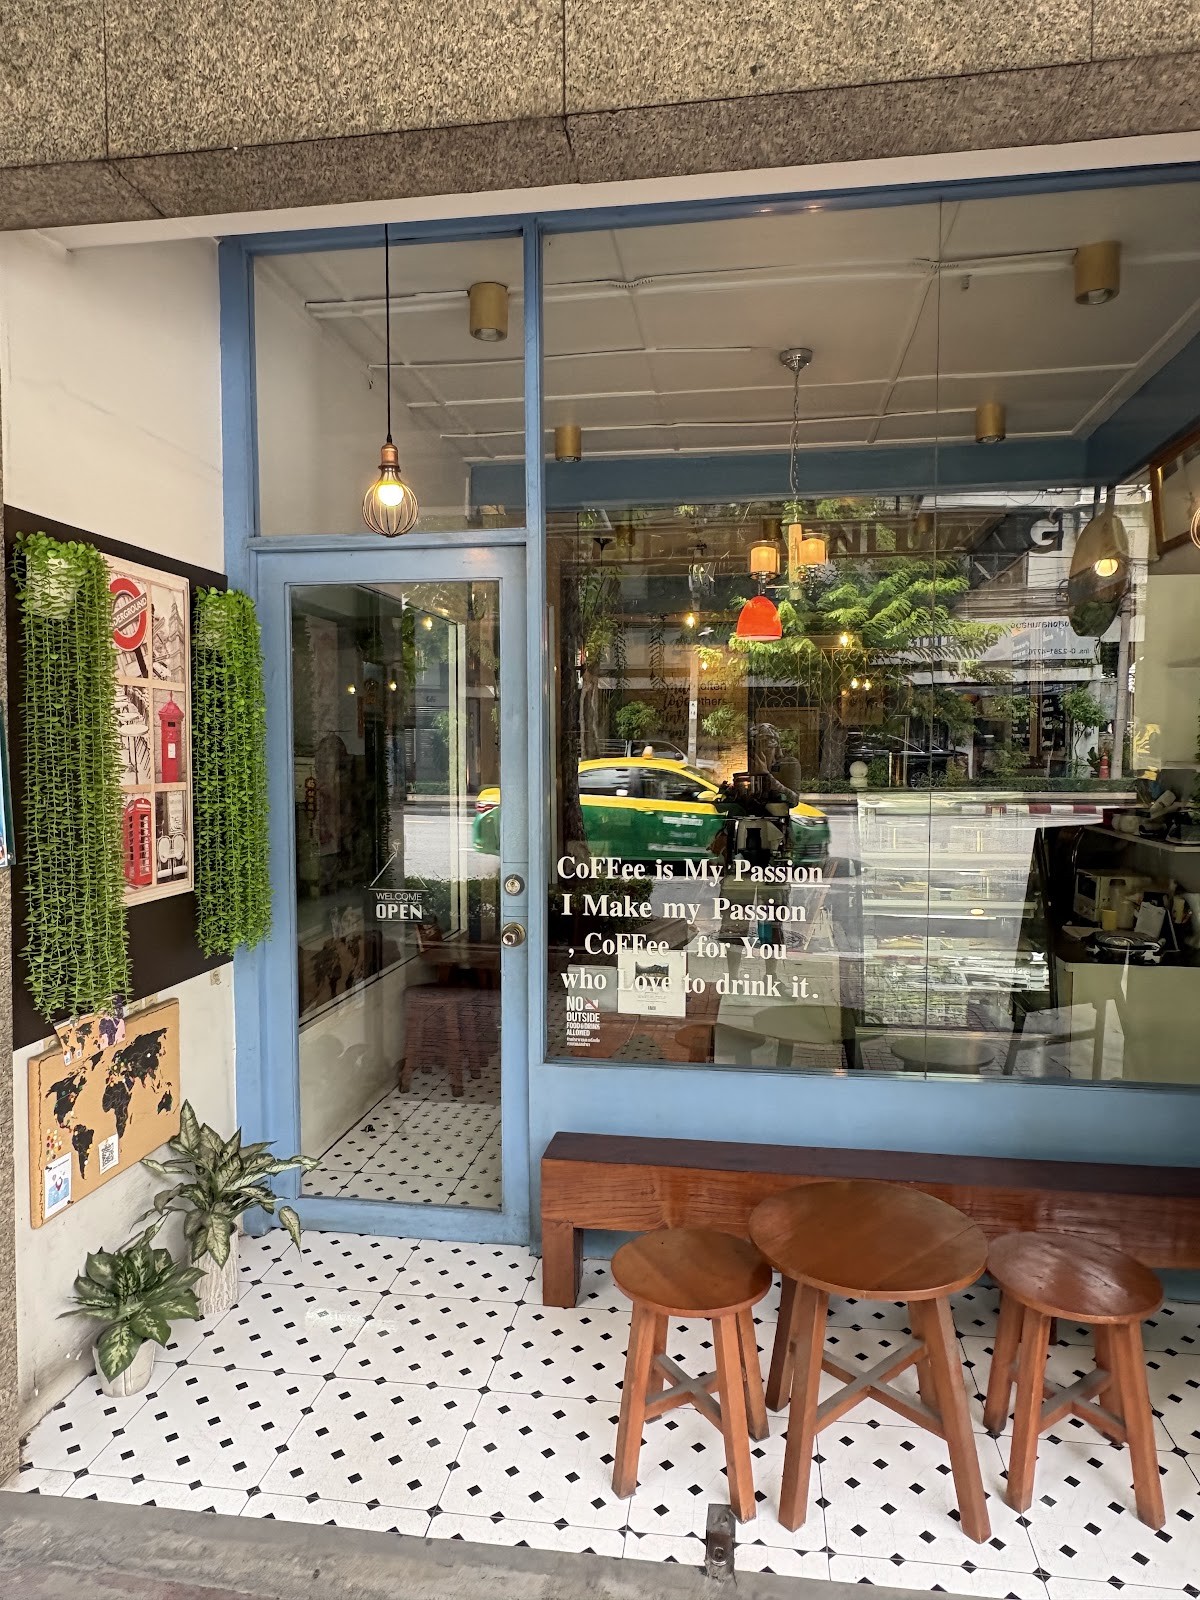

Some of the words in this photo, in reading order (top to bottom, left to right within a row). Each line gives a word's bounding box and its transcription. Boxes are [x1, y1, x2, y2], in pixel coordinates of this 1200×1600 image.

[112, 597, 147, 626] DERGROUND
[557, 856, 646, 880] CoFFee
[656, 859, 674, 881] is
[684, 858, 724, 887] My
[734, 859, 824, 884] Passion
[376, 904, 422, 919] OPEN
[560, 893, 573, 916] I
[583, 894, 652, 918] Make
[663, 902, 701, 925] my
[712, 897, 807, 922] Passion
[584, 932, 670, 957] CoFFee
[697, 936, 731, 959] for
[740, 936, 788, 960] You
[560, 967, 607, 990] who
[617, 968, 673, 993] Love
[683, 972, 706, 994] to
[715, 973, 782, 998] drink
[566, 996, 584, 1011] NO
[566, 1011, 600, 1023] OUTSIDE
[566, 1028, 591, 1037] ALLOWED
